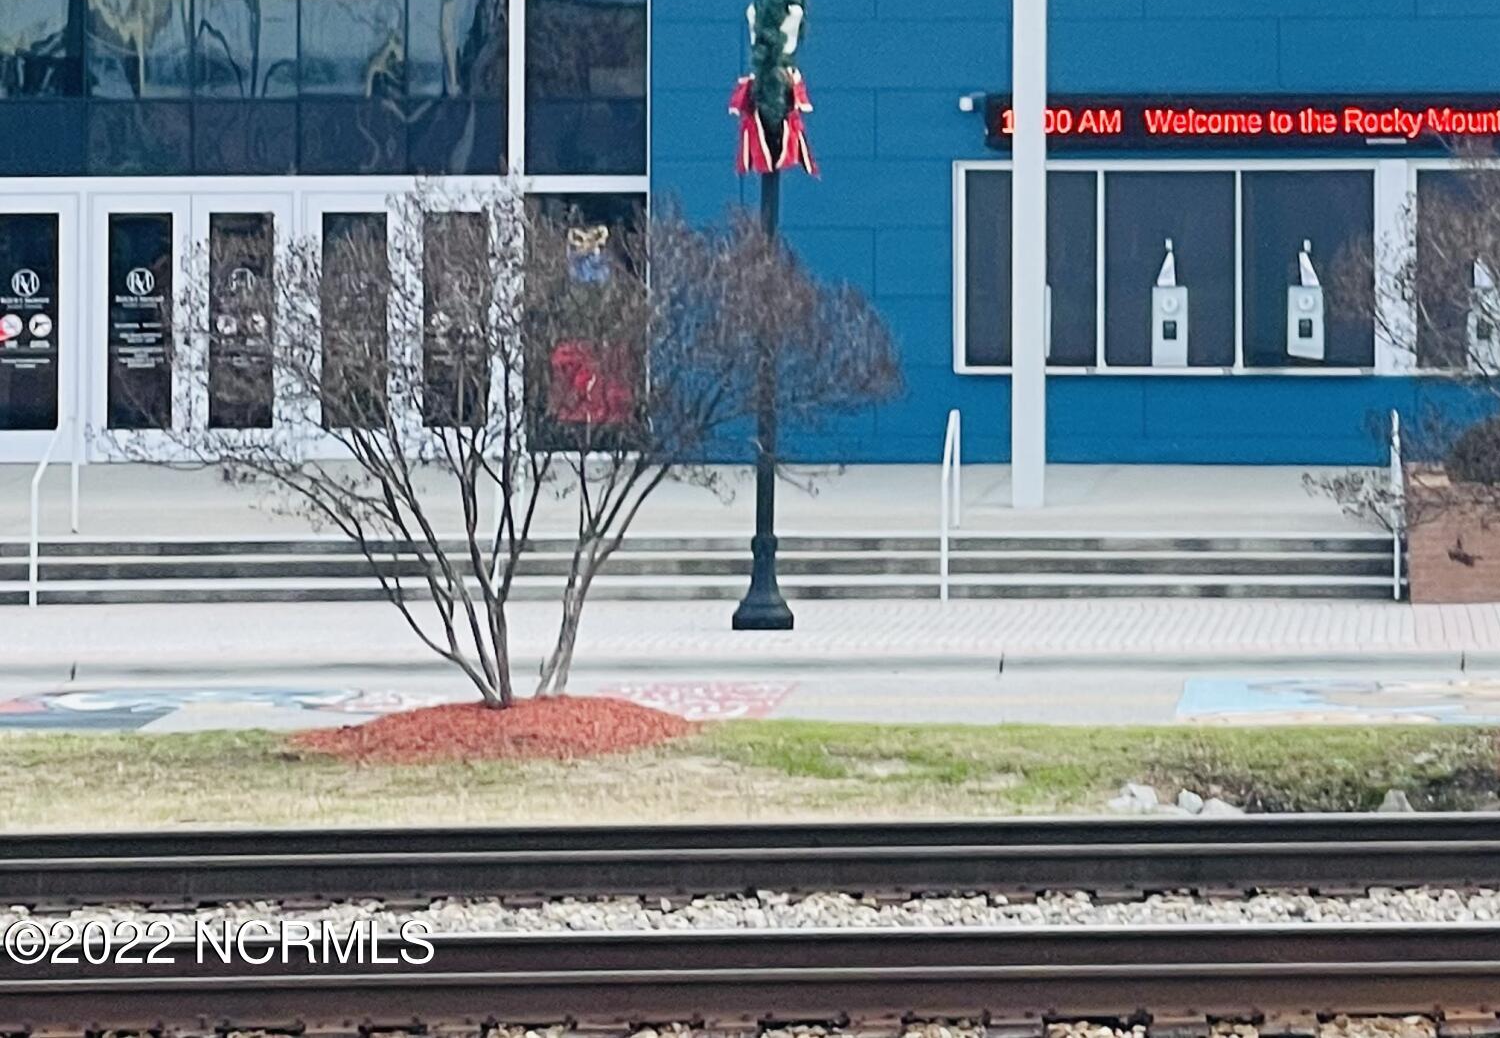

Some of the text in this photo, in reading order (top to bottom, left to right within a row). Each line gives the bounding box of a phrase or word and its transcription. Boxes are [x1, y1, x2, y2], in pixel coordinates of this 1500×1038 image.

[1077, 109, 1122, 134] AM
[1144, 108, 1263, 134] Welcome
[1268, 109, 1294, 134] to
[1299, 107, 1338, 134] the
[1343, 107, 1424, 139] Rocky
